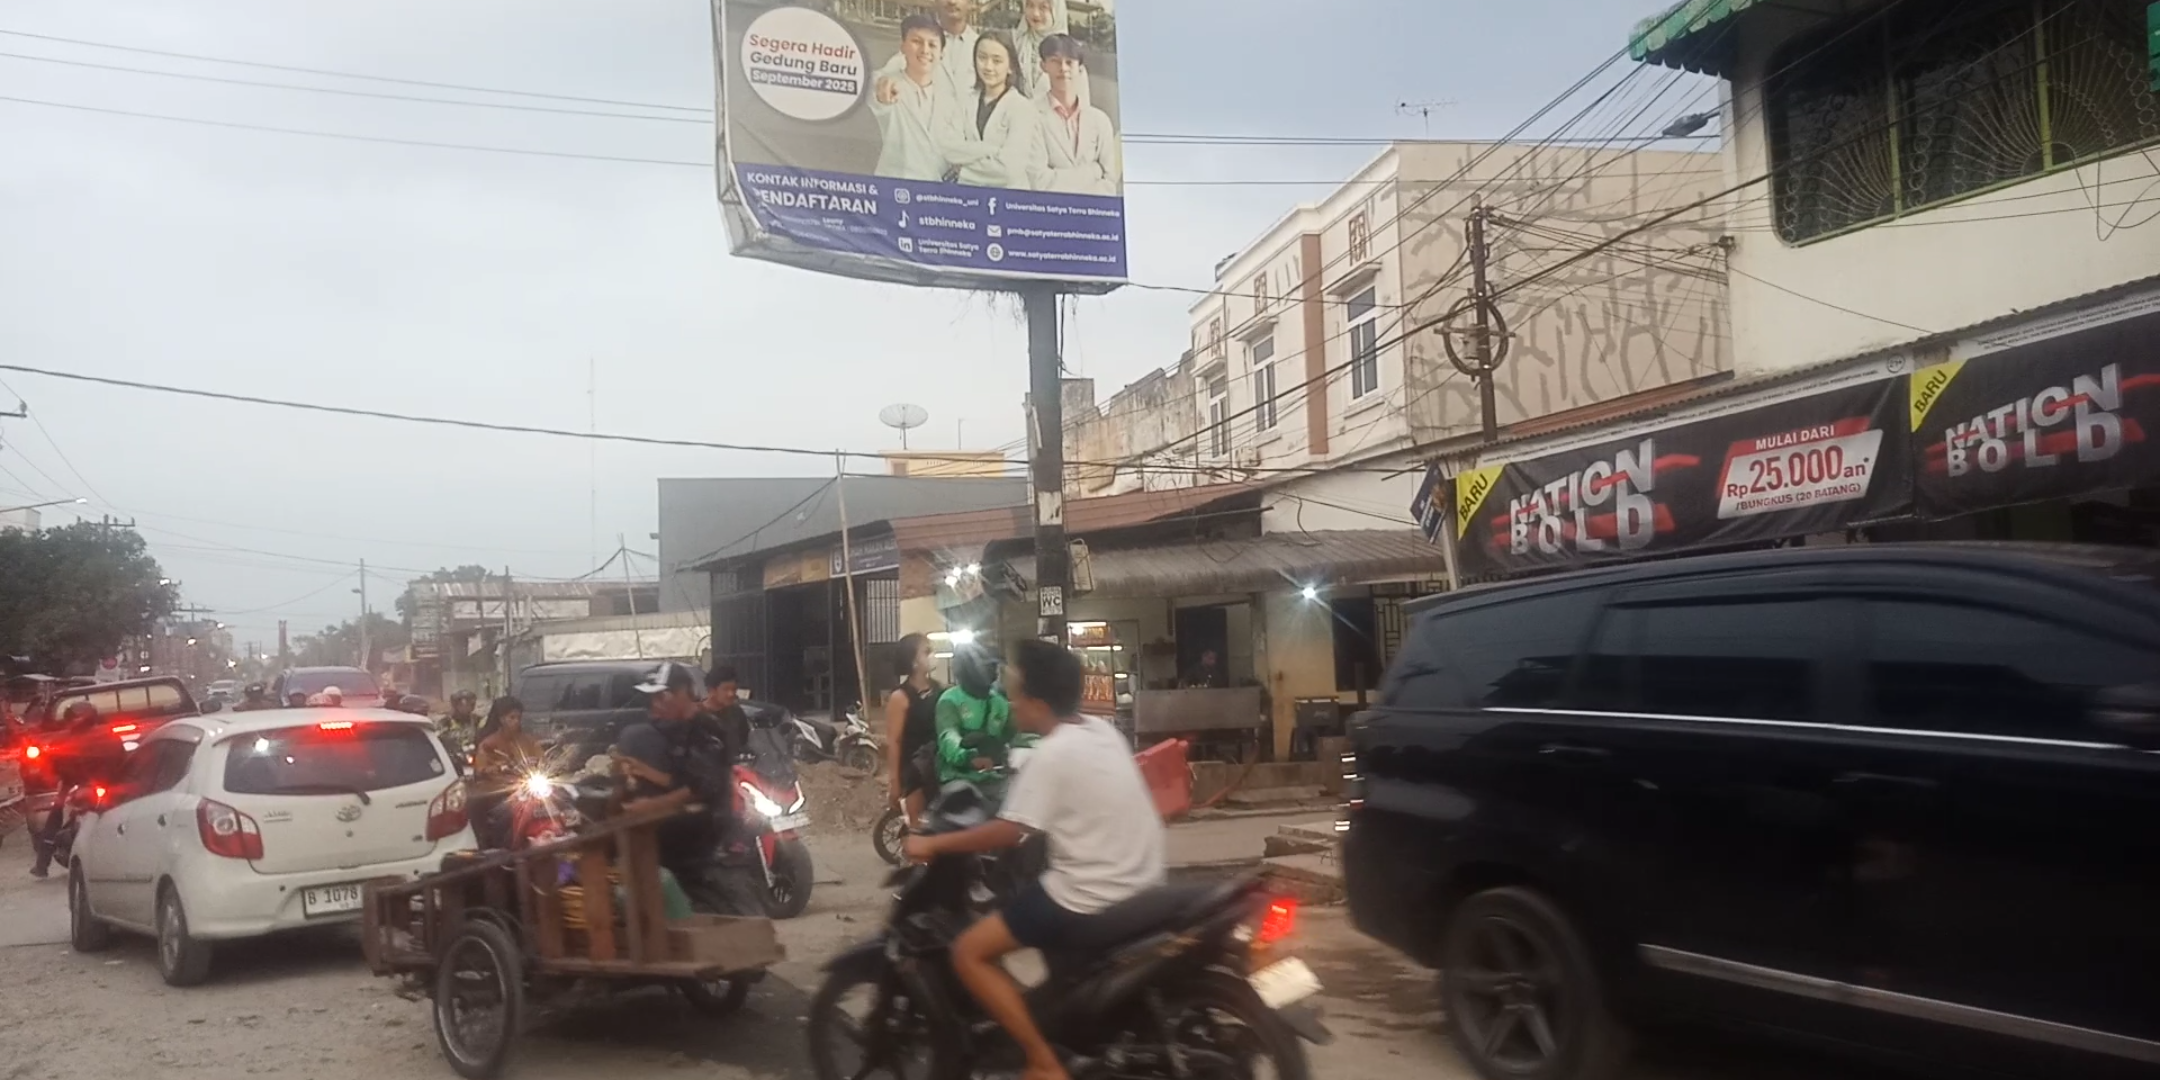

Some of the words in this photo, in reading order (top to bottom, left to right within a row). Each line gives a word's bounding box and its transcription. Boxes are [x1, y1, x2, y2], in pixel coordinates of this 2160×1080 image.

[749, 33, 807, 53] Segera
[811, 42, 856, 59] Hadir
[750, 51, 815, 74] Gedung
[820, 60, 857, 76] Baru
[752, 69, 823, 89] September
[825, 79, 855, 92] 2025
[747, 172, 798, 188] KONTAK
[800, 177, 866, 195] INFORMASI
[868, 184, 879, 196] &
[1005, 202, 1046, 213] Universitas
[919, 216, 976, 229] stbhinneka
[1913, 369, 1948, 414] BARU
[1945, 362, 2122, 450] NATION
[1755, 434, 1797, 451] MULAI
[1800, 424, 1835, 442] DARI
[1948, 411, 2123, 478] BOLD
[1510, 438, 1655, 525] NATION
[1458, 472, 1489, 522] BARU
[1735, 495, 1793, 511] /BUNGKUS
[1795, 491, 1812, 504] (20
[1814, 483, 1862, 499] BATANG)
[1510, 492, 1654, 555] BOLD
[1042, 596, 1061, 607] WC
[308, 891, 317, 905] B
